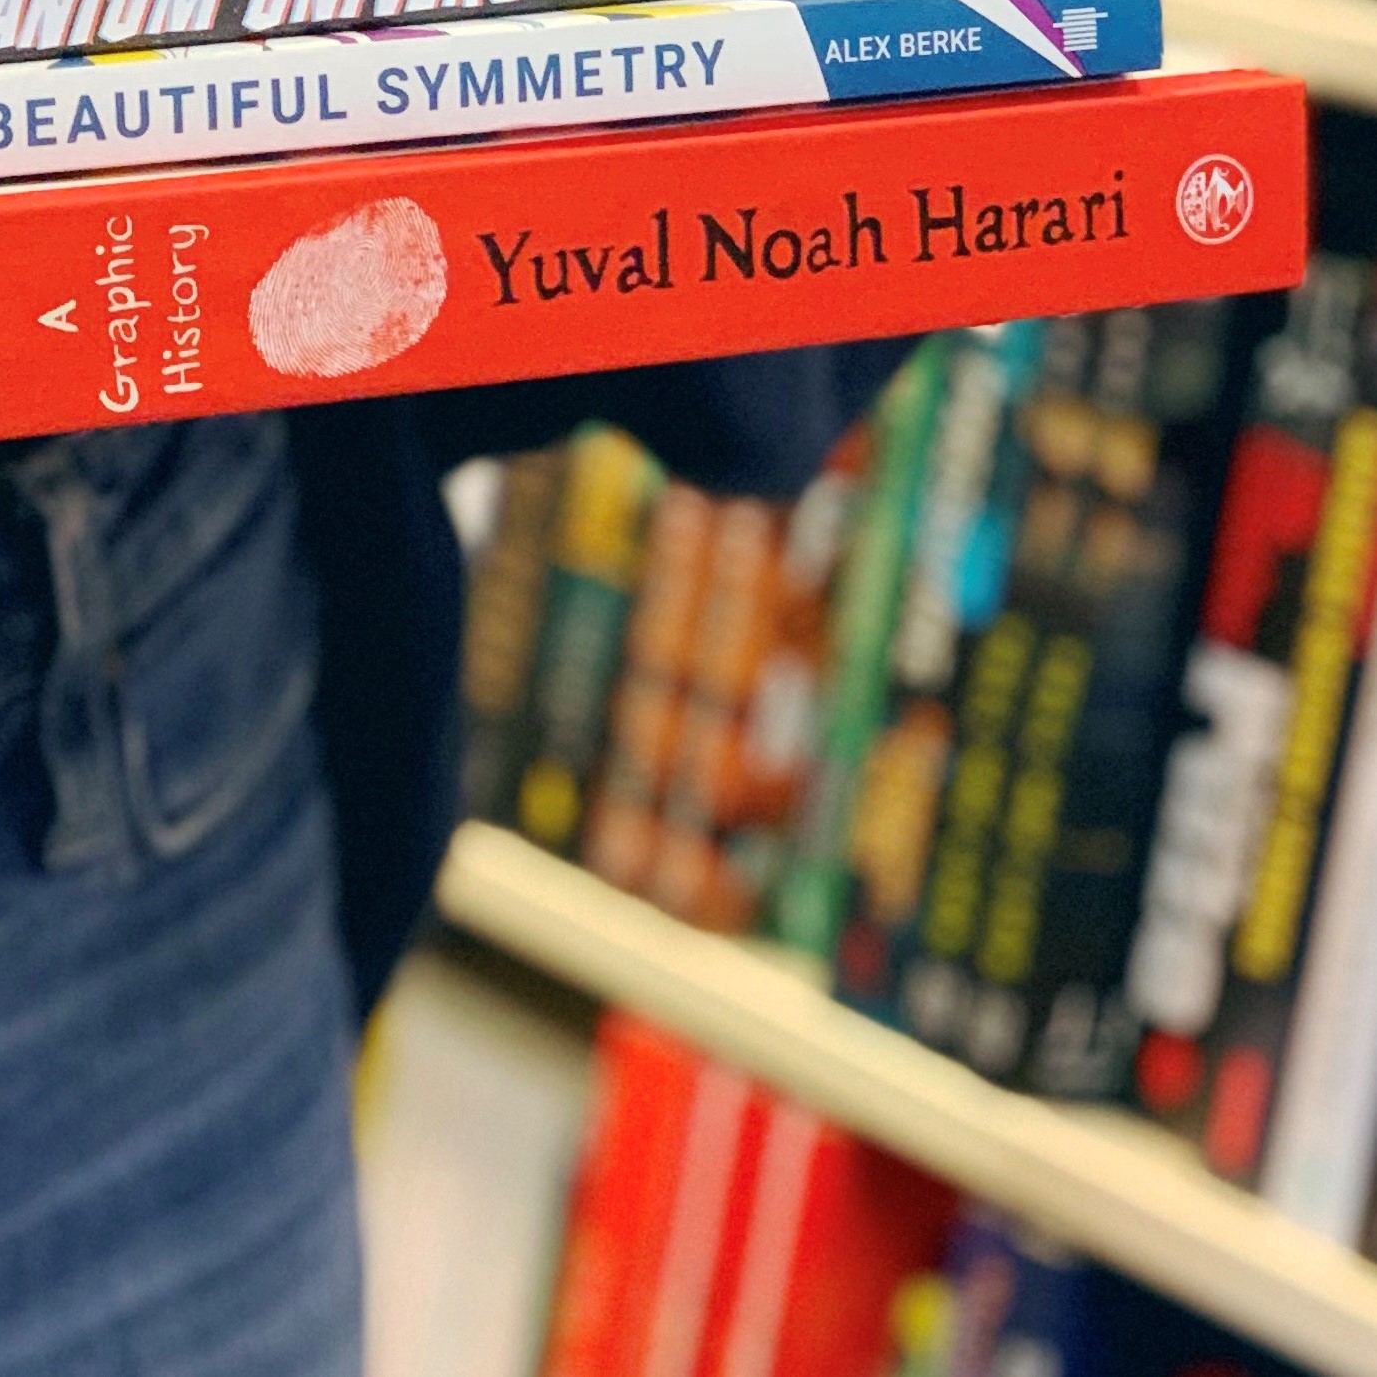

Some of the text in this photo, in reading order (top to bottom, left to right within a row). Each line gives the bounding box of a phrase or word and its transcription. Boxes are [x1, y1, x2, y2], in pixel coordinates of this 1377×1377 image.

[376, 38, 726, 117] SYMMETRY
[825, 26, 983, 65] ALEX BERKE
[478, 169, 1129, 306] Yuval Noah Harari
[37, 299, 79, 334] A
[95, 213, 142, 414] Graphic
[162, 223, 210, 394] History
